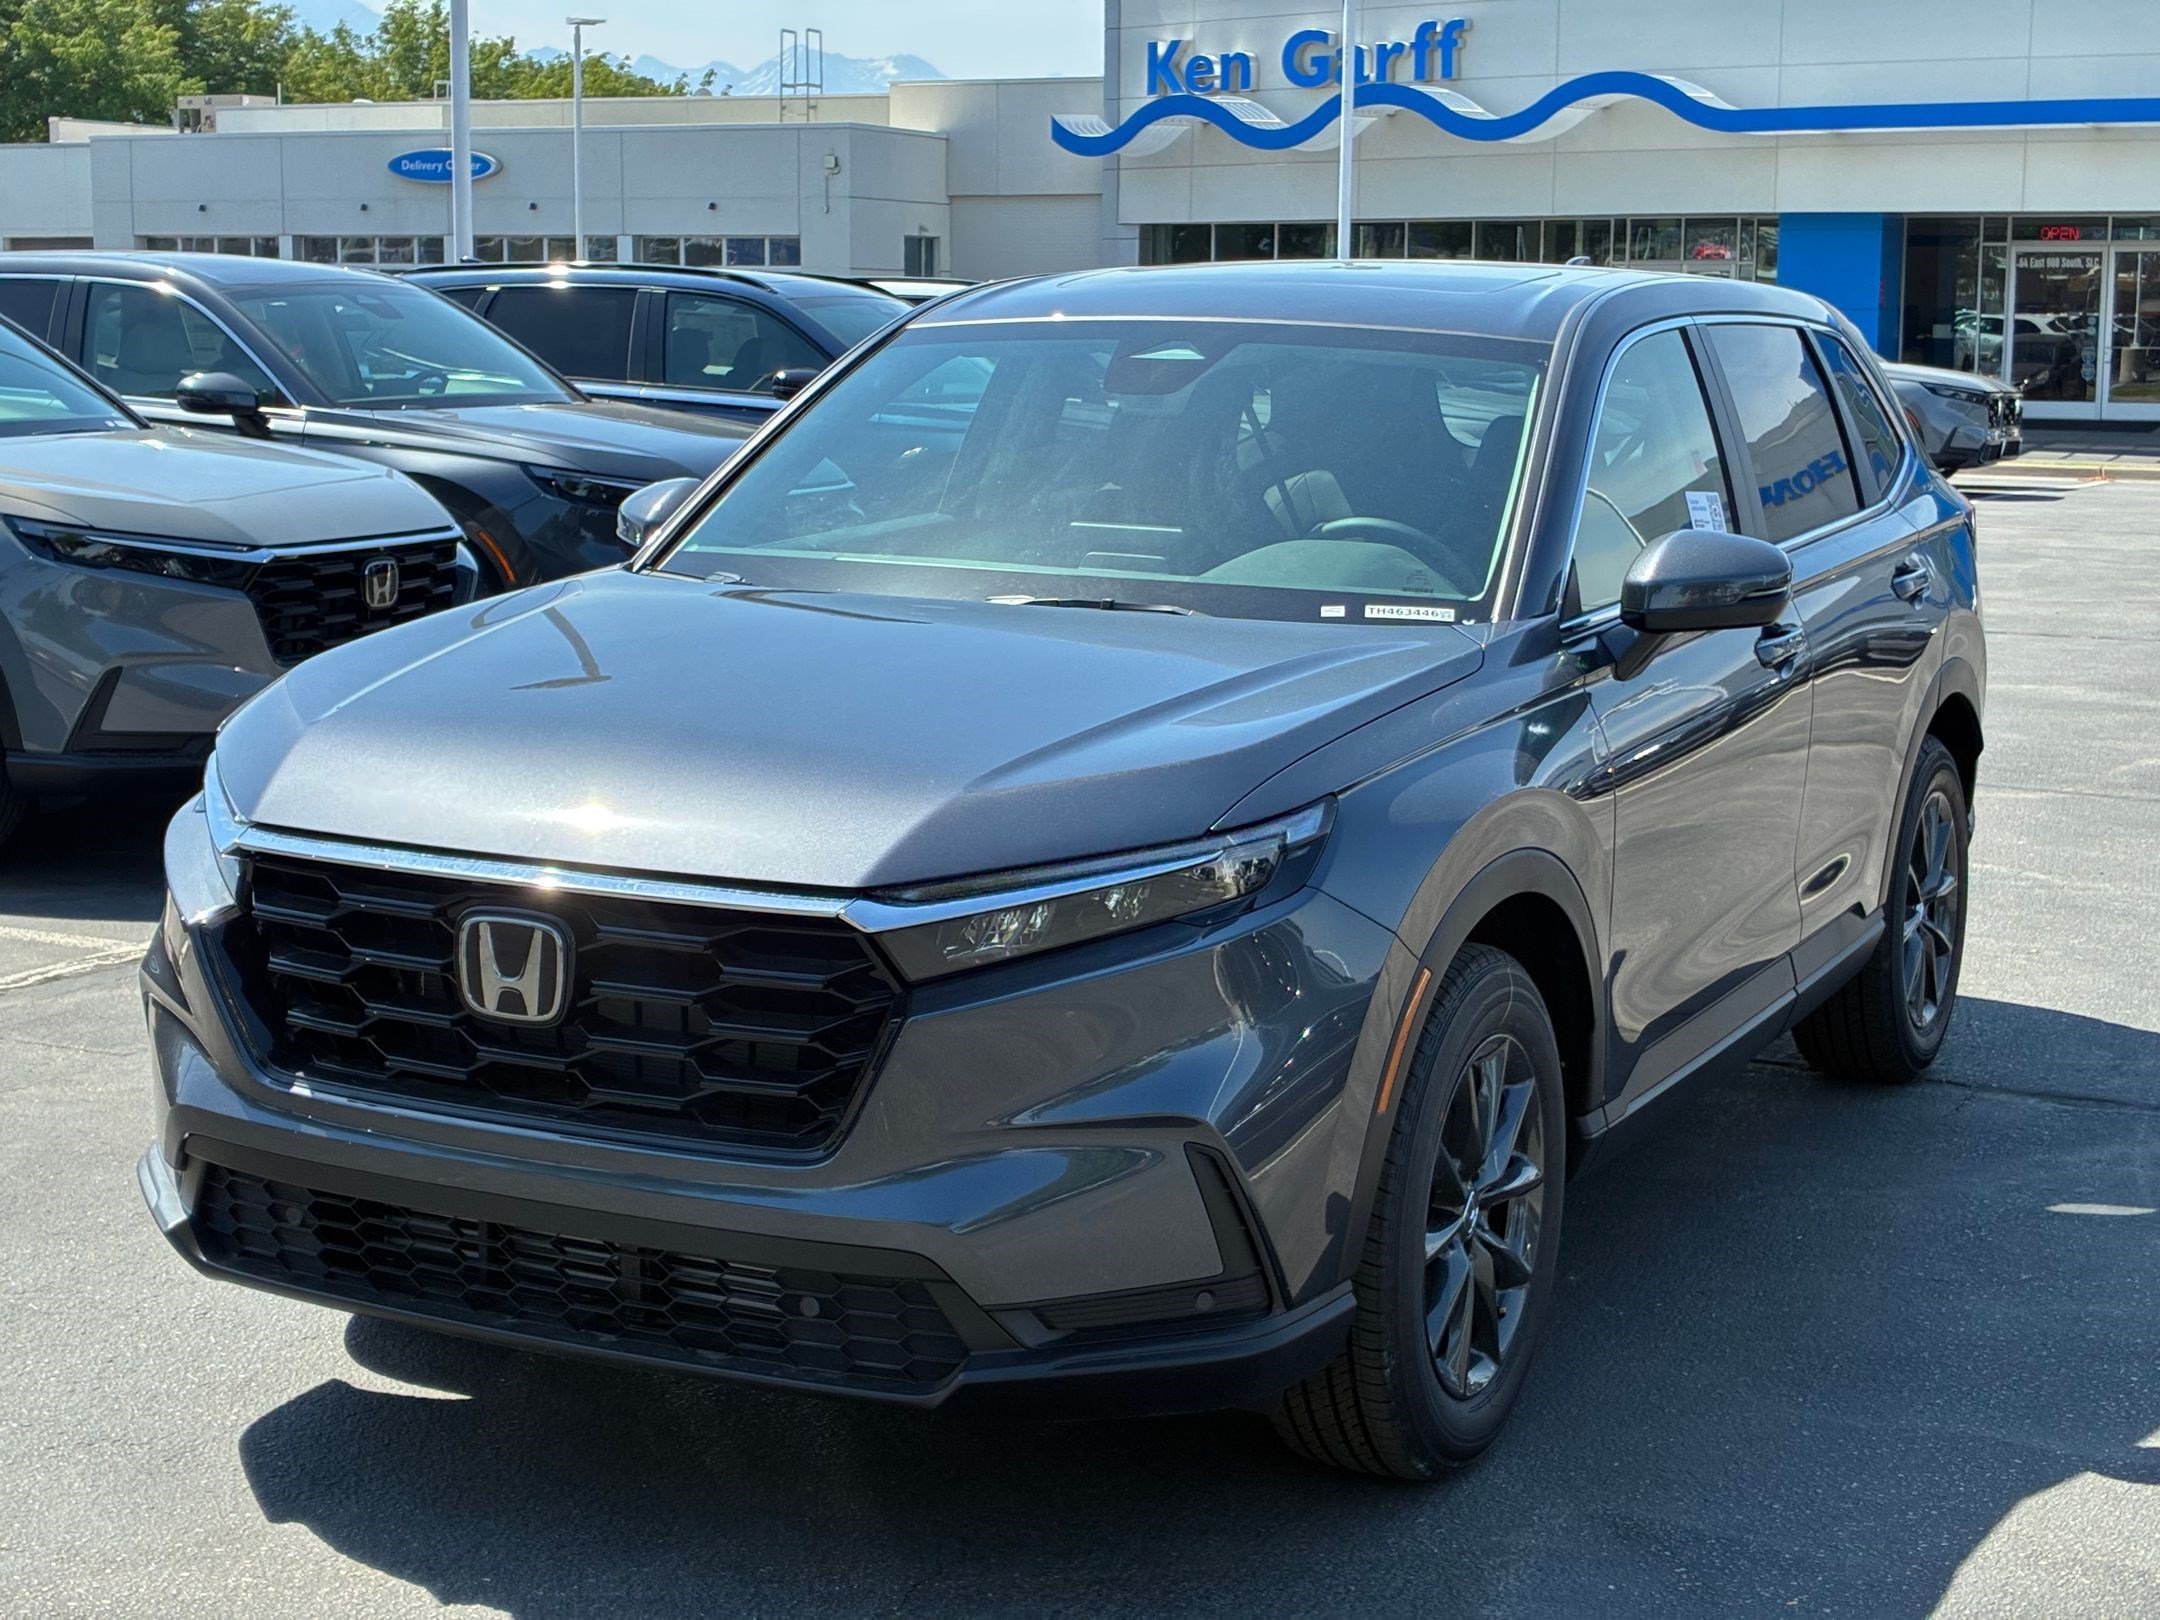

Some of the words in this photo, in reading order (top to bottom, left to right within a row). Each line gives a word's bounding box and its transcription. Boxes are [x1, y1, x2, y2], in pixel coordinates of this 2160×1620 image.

[1147, 40, 1254, 96] Ken
[1282, 19, 1468, 88] Garff
[401, 160, 443, 173] Delivery
[2040, 227, 2080, 240] OPEN
[2030, 257, 2045, 268] East
[1368, 606, 1439, 617] TH463446
